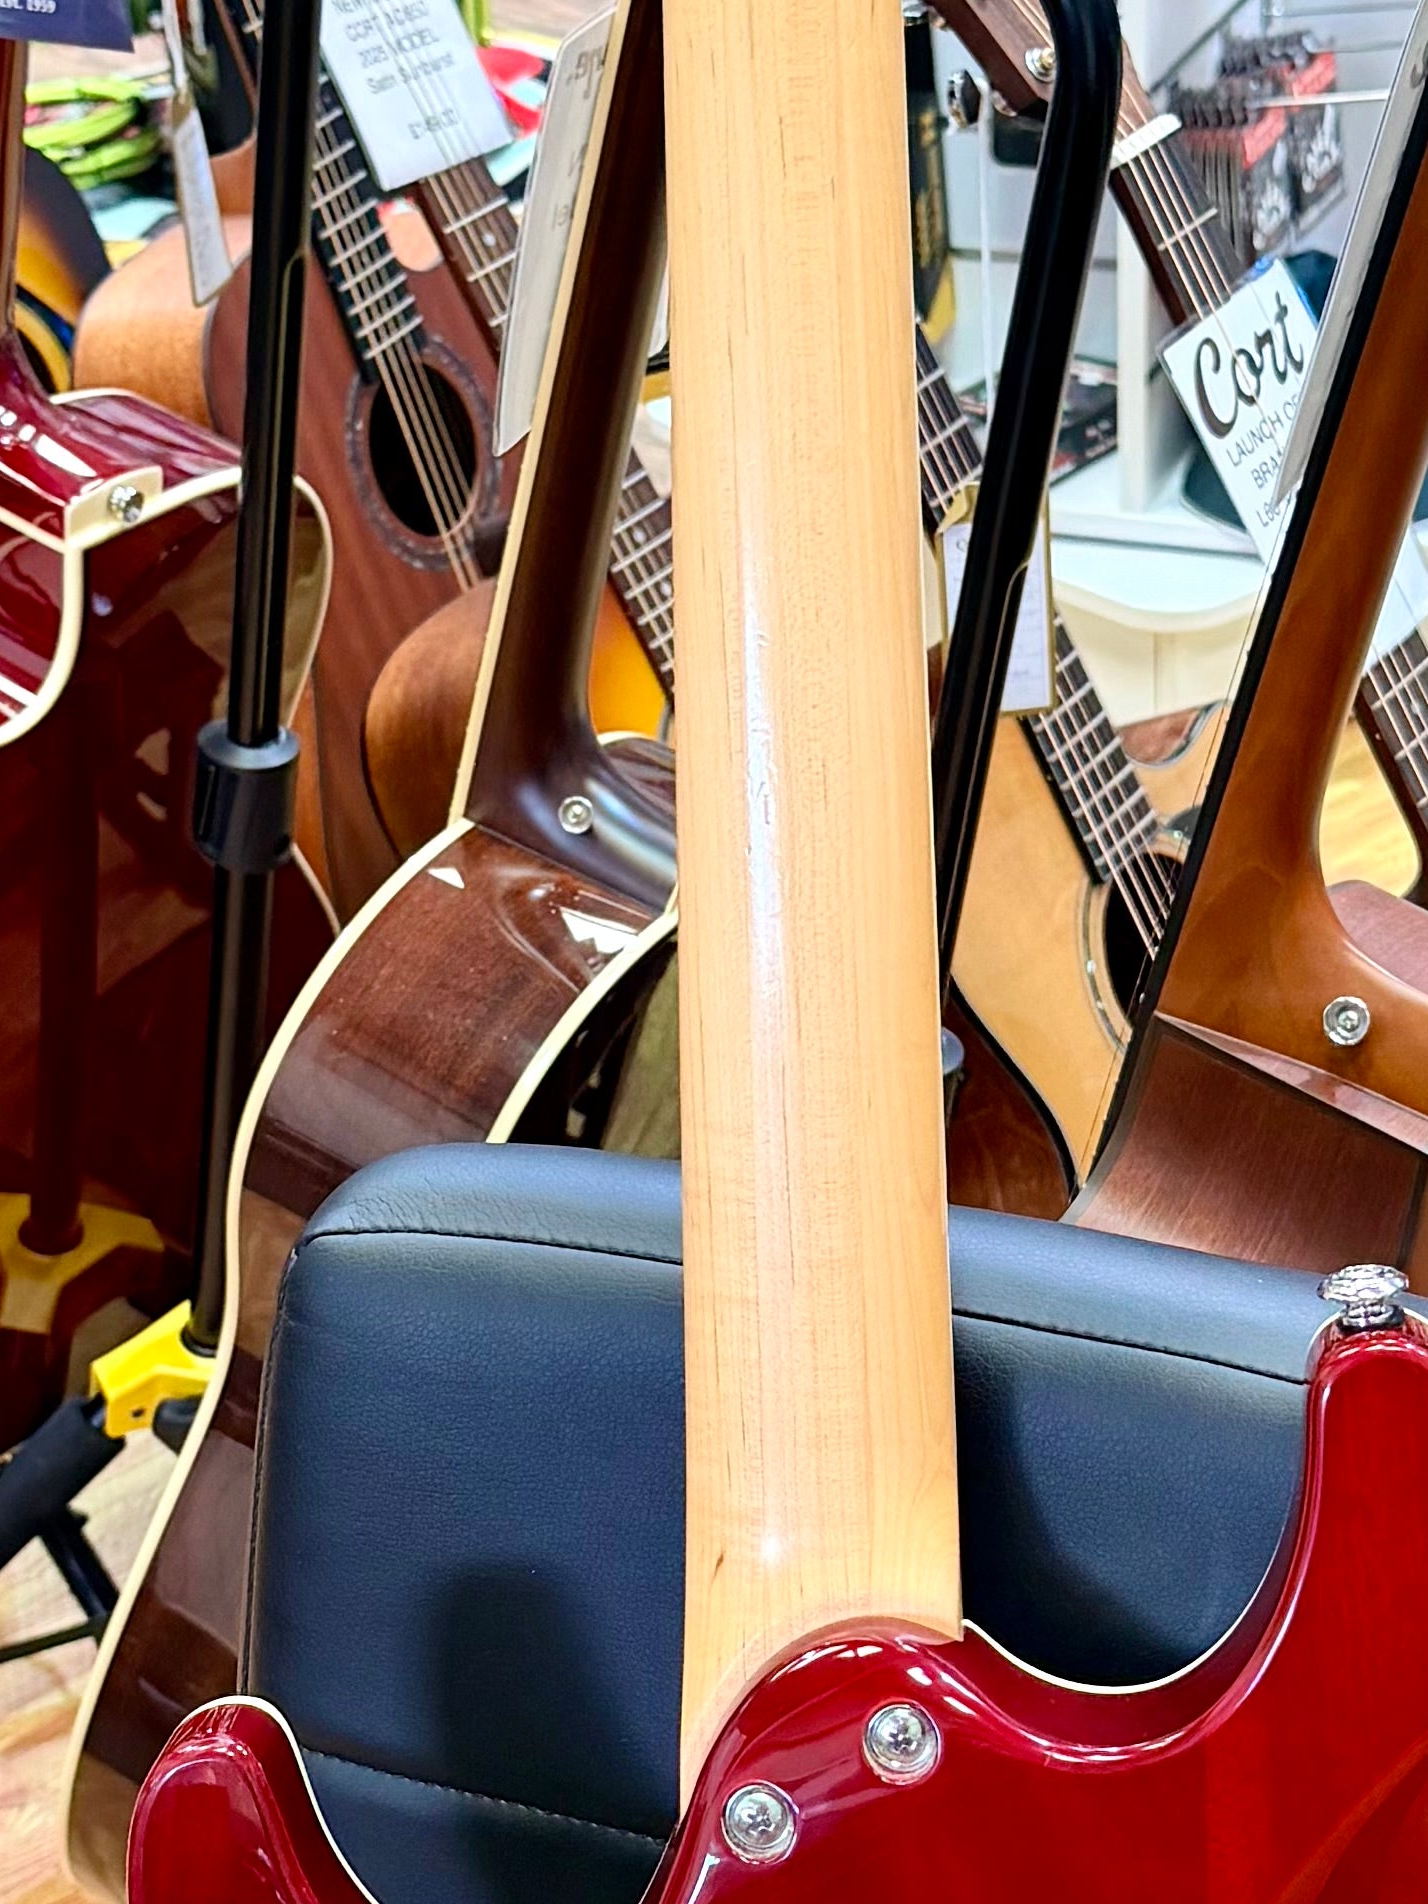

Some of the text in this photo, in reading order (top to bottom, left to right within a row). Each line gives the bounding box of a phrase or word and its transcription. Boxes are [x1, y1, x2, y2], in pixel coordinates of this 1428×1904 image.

[394, 27, 441, 54] MODEL
[1194, 290, 1305, 441] Cort
[1226, 409, 1286, 468] LAUNCH
